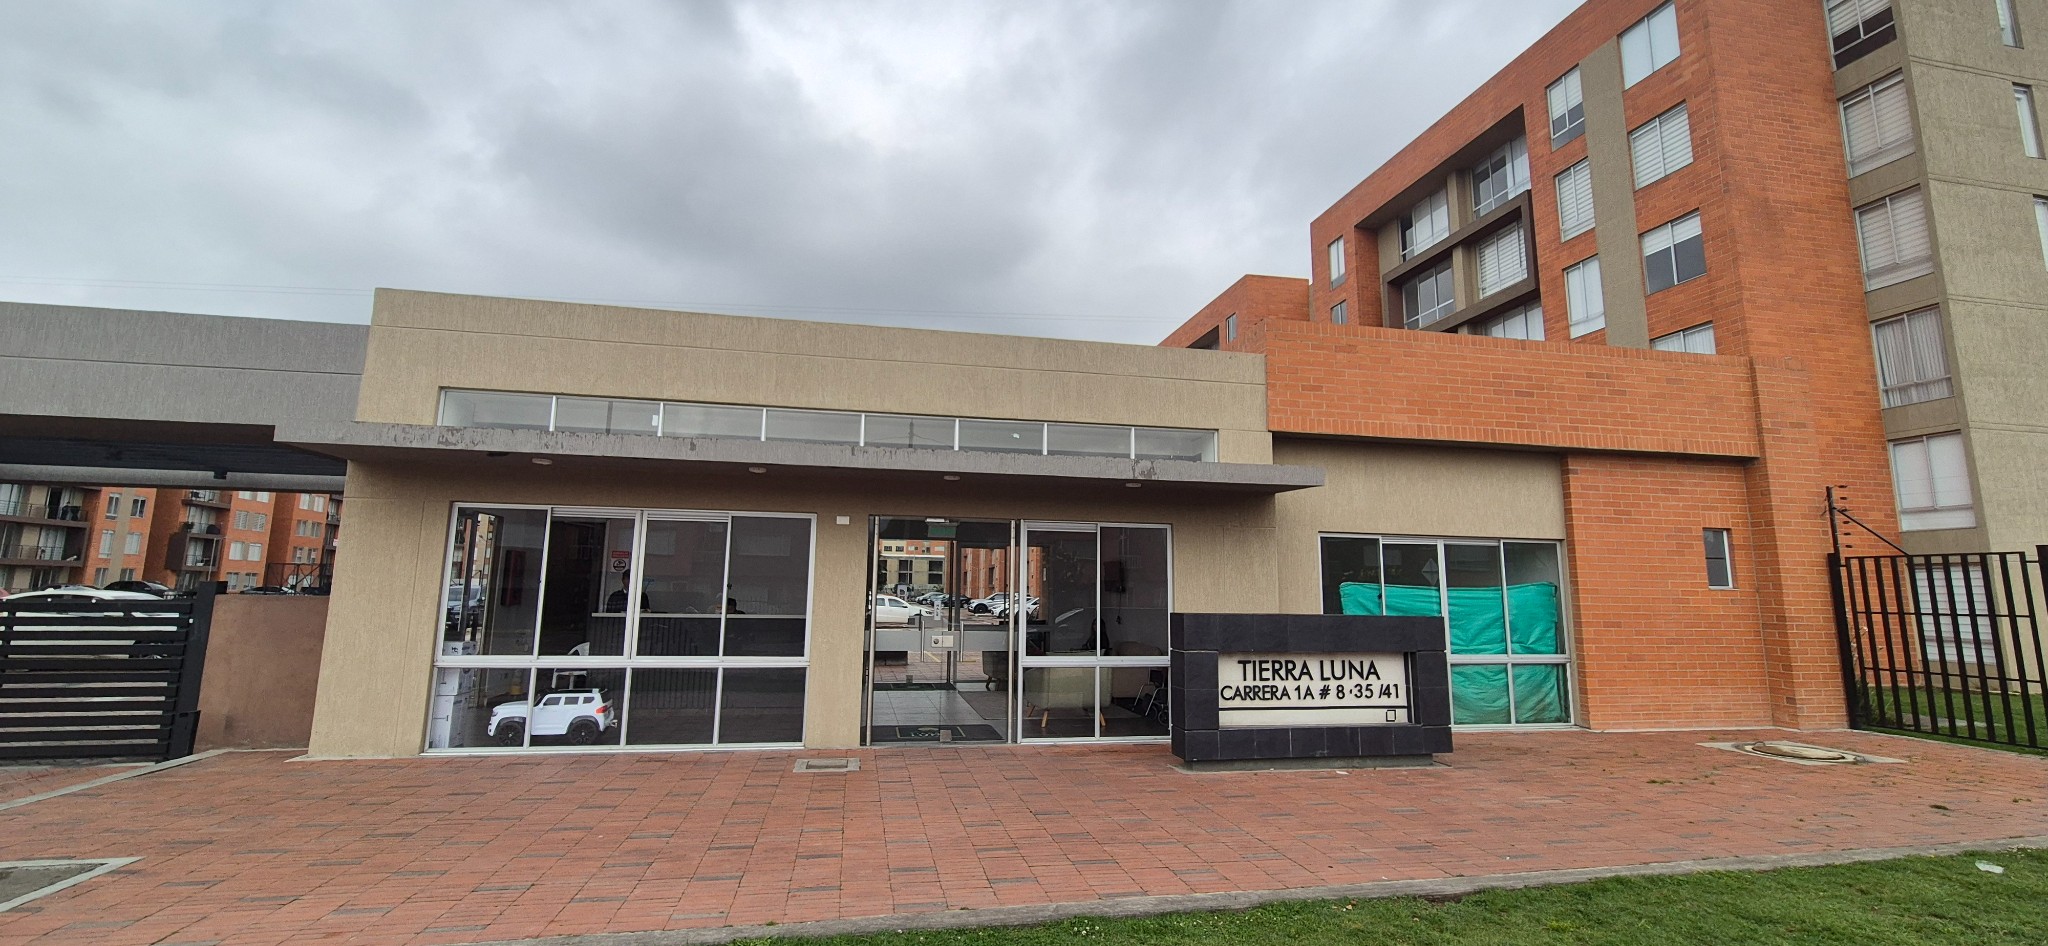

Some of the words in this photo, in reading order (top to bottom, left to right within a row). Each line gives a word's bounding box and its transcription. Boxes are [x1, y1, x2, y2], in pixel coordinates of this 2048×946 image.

[1238, 660, 1314, 681] TIERRA
[1319, 660, 1381, 681] LUNA
[1220, 685, 1291, 701] CARRERA
[1294, 685, 1315, 700] 1A
[1319, 685, 1331, 700] #
